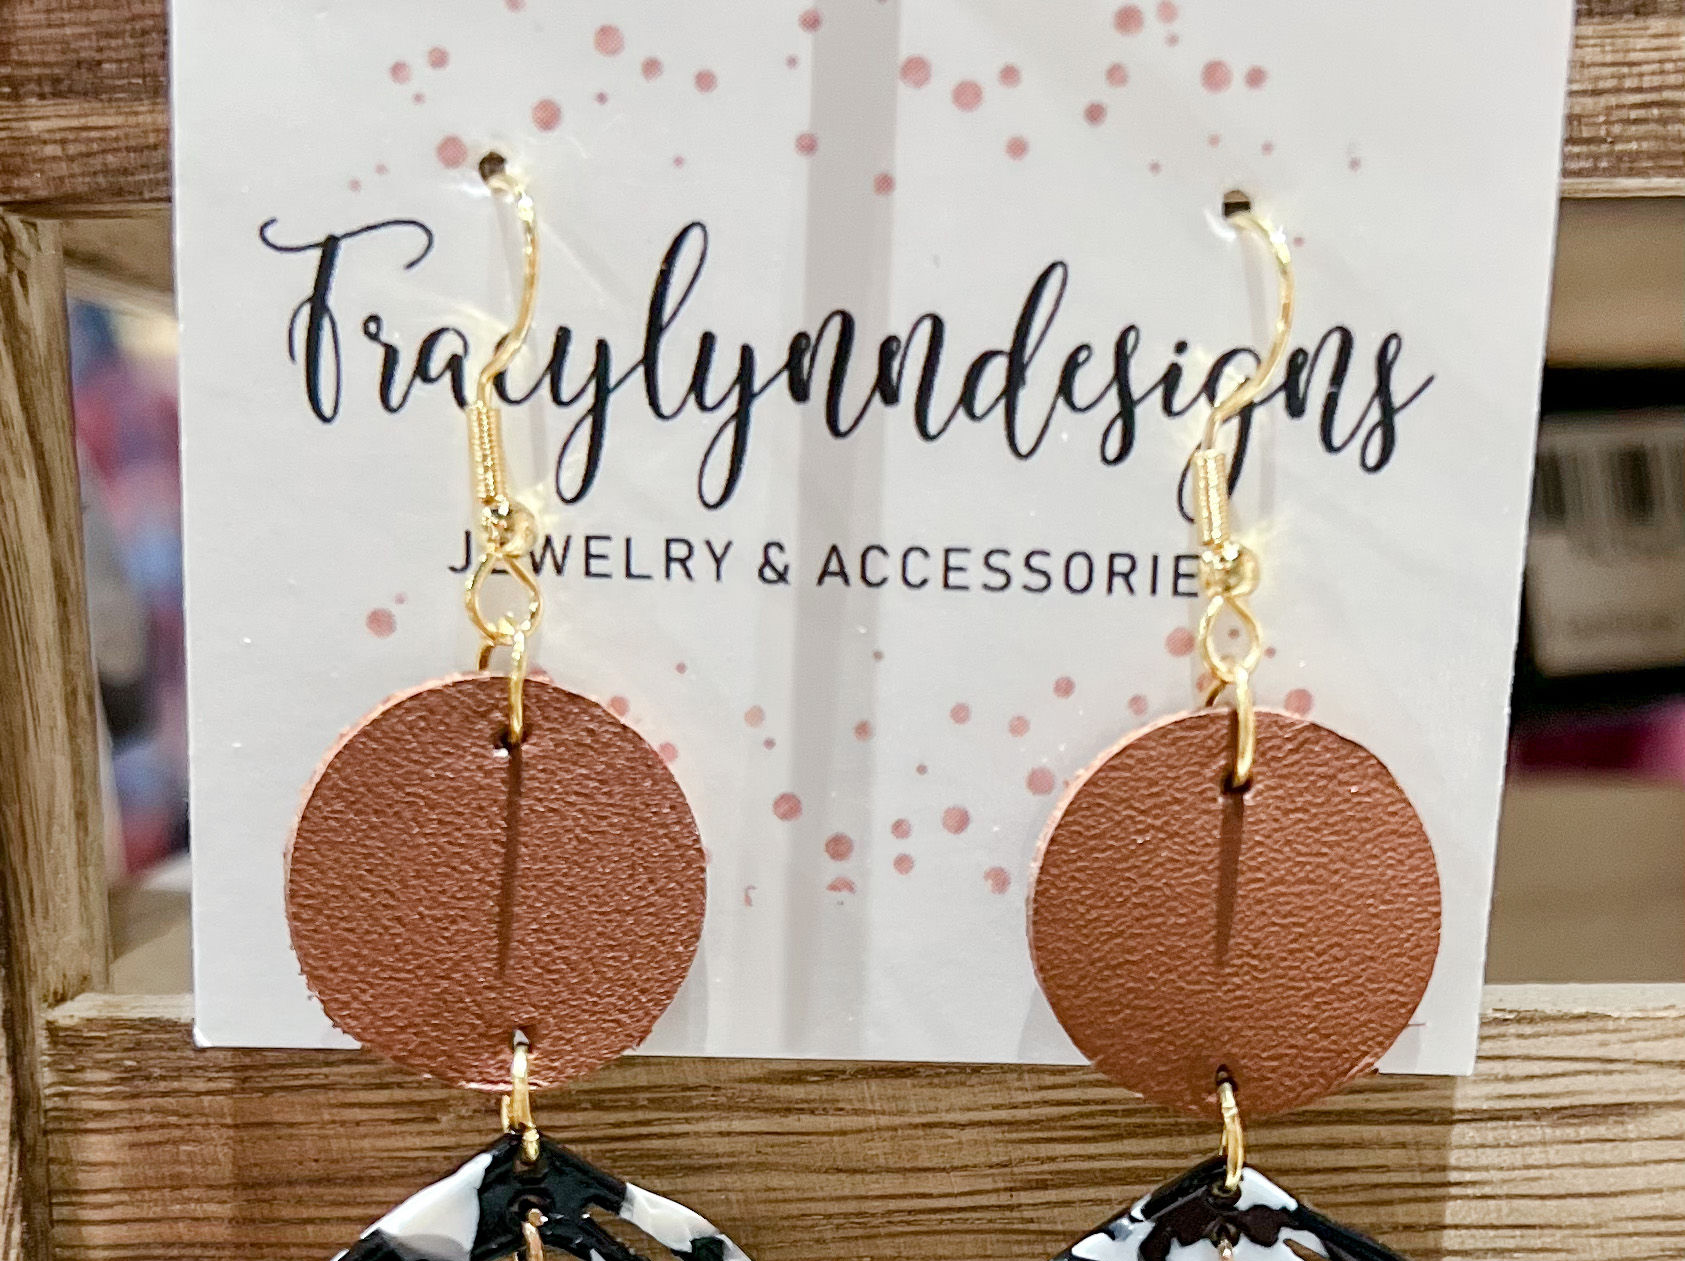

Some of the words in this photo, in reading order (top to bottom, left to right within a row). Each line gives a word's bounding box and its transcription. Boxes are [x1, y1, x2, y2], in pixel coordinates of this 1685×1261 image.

[447, 529, 734, 583] JWELRY
[757, 541, 791, 586] &
[816, 543, 1202, 598] ACCESSORIE
